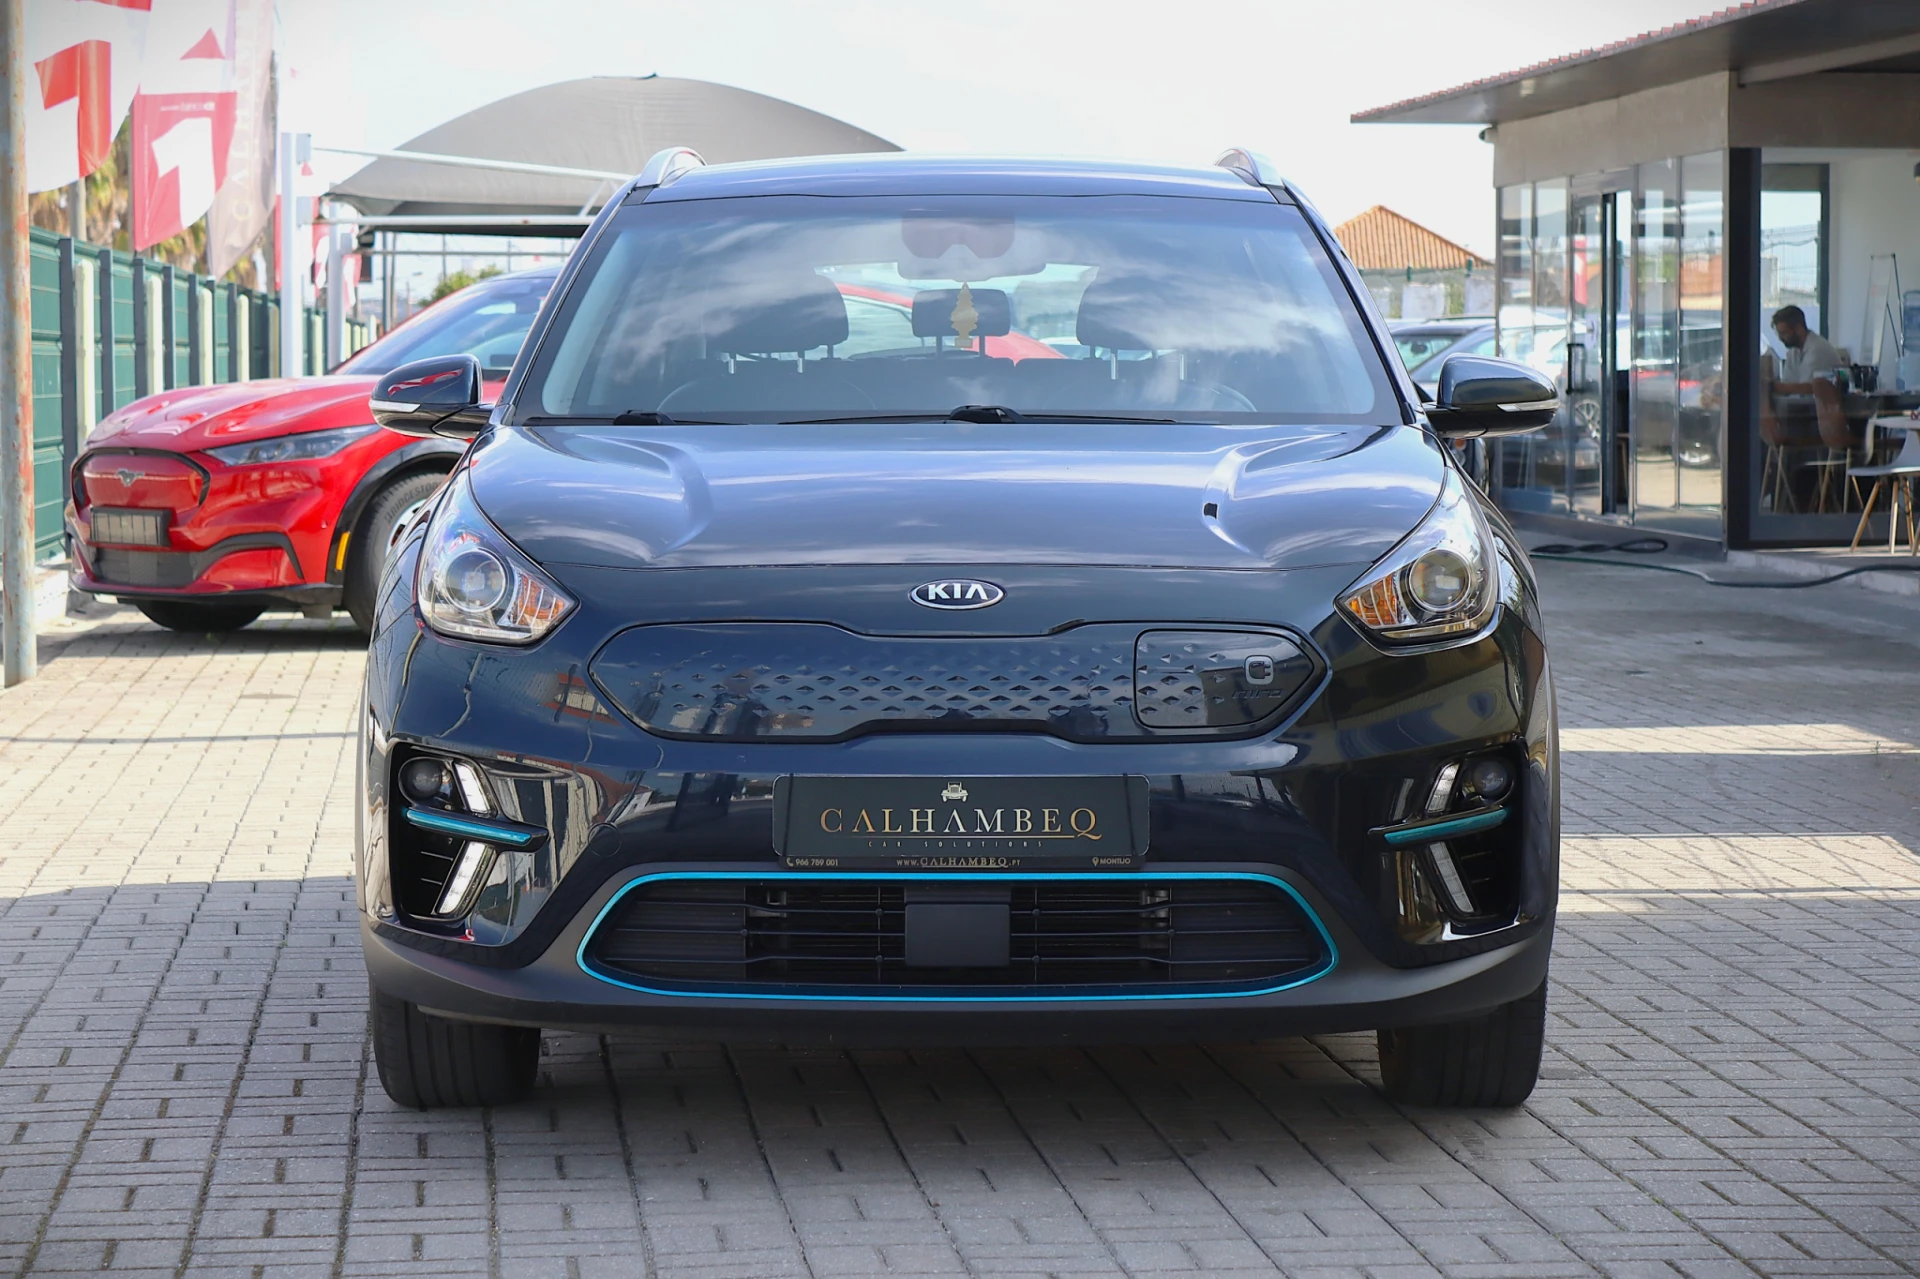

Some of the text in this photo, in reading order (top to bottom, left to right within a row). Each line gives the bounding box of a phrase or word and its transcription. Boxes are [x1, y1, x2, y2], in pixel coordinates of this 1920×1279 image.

[927, 582, 989, 601] KIA
[819, 807, 1103, 841] CALHAMBEQ
[924, 841, 1042, 849] SOLUTIONS
